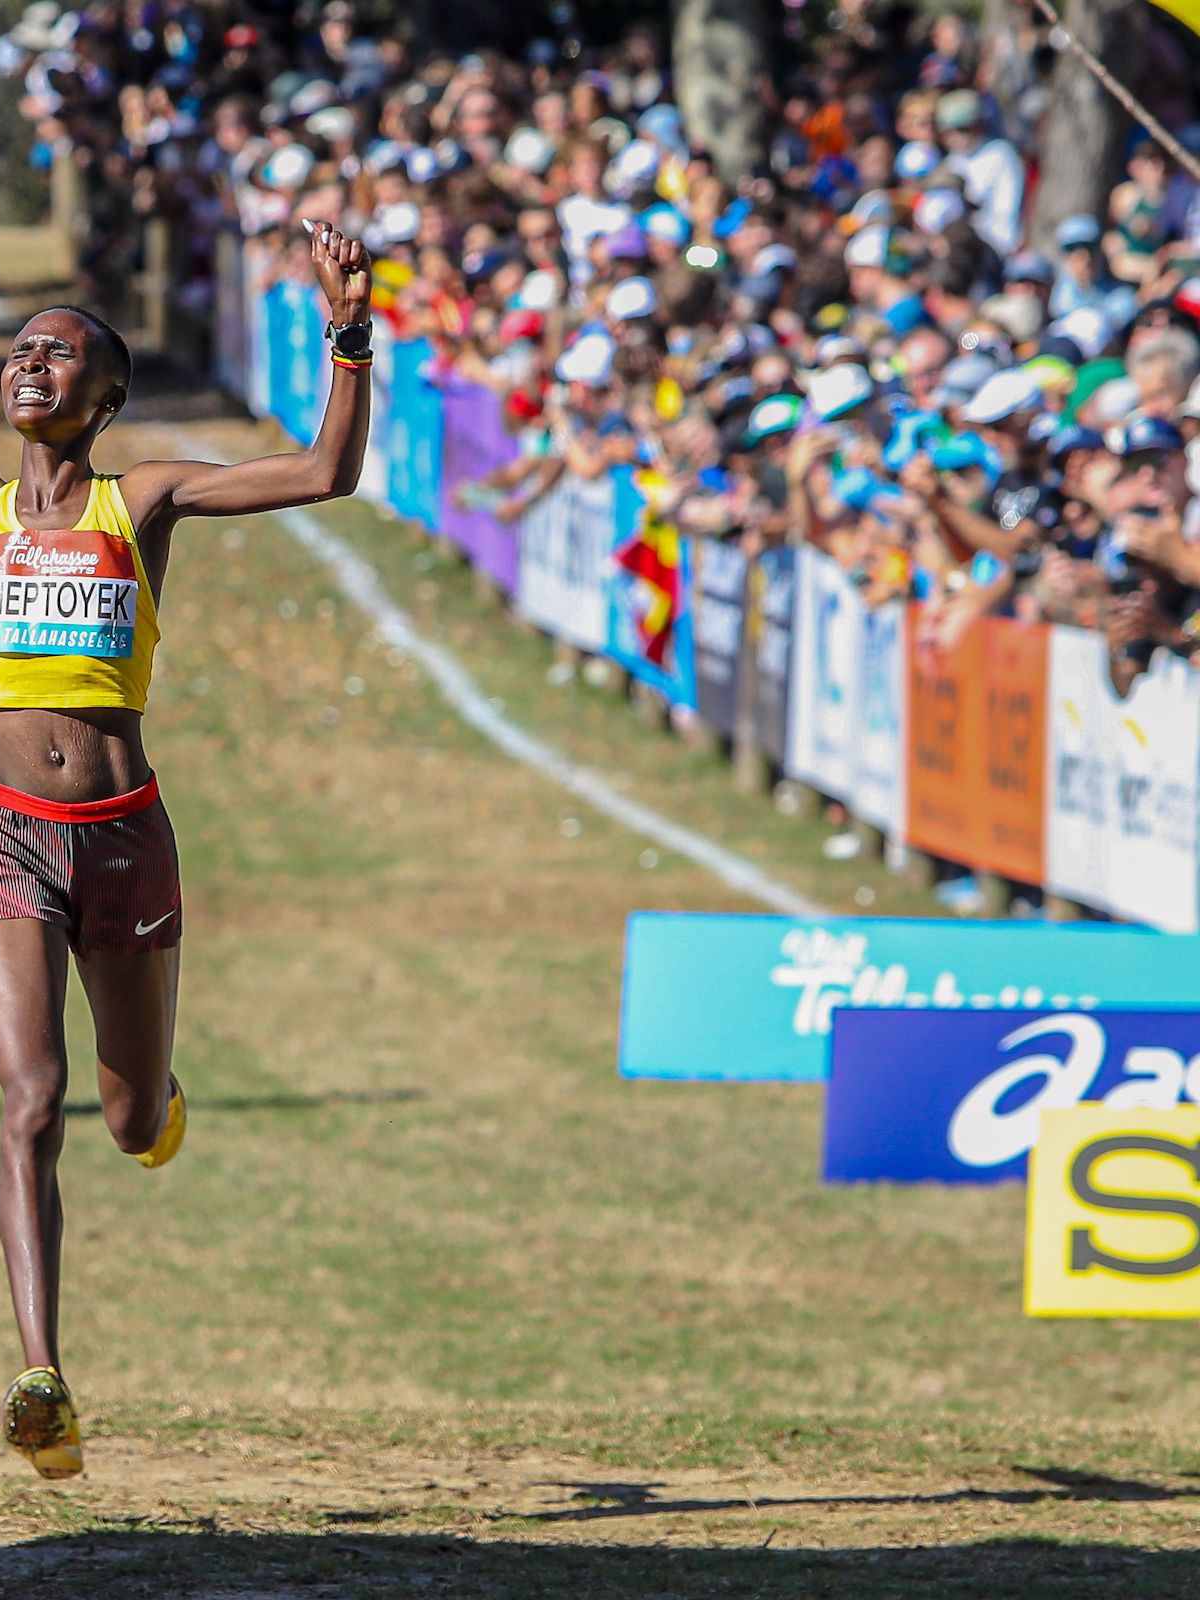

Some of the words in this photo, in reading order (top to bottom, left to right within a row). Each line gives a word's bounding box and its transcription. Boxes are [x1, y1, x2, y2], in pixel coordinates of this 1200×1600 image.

[4, 545, 99, 570] Tallahassee
[41, 566, 96, 574] SPORTS
[3, 627, 104, 648] TALLAHASSEE
